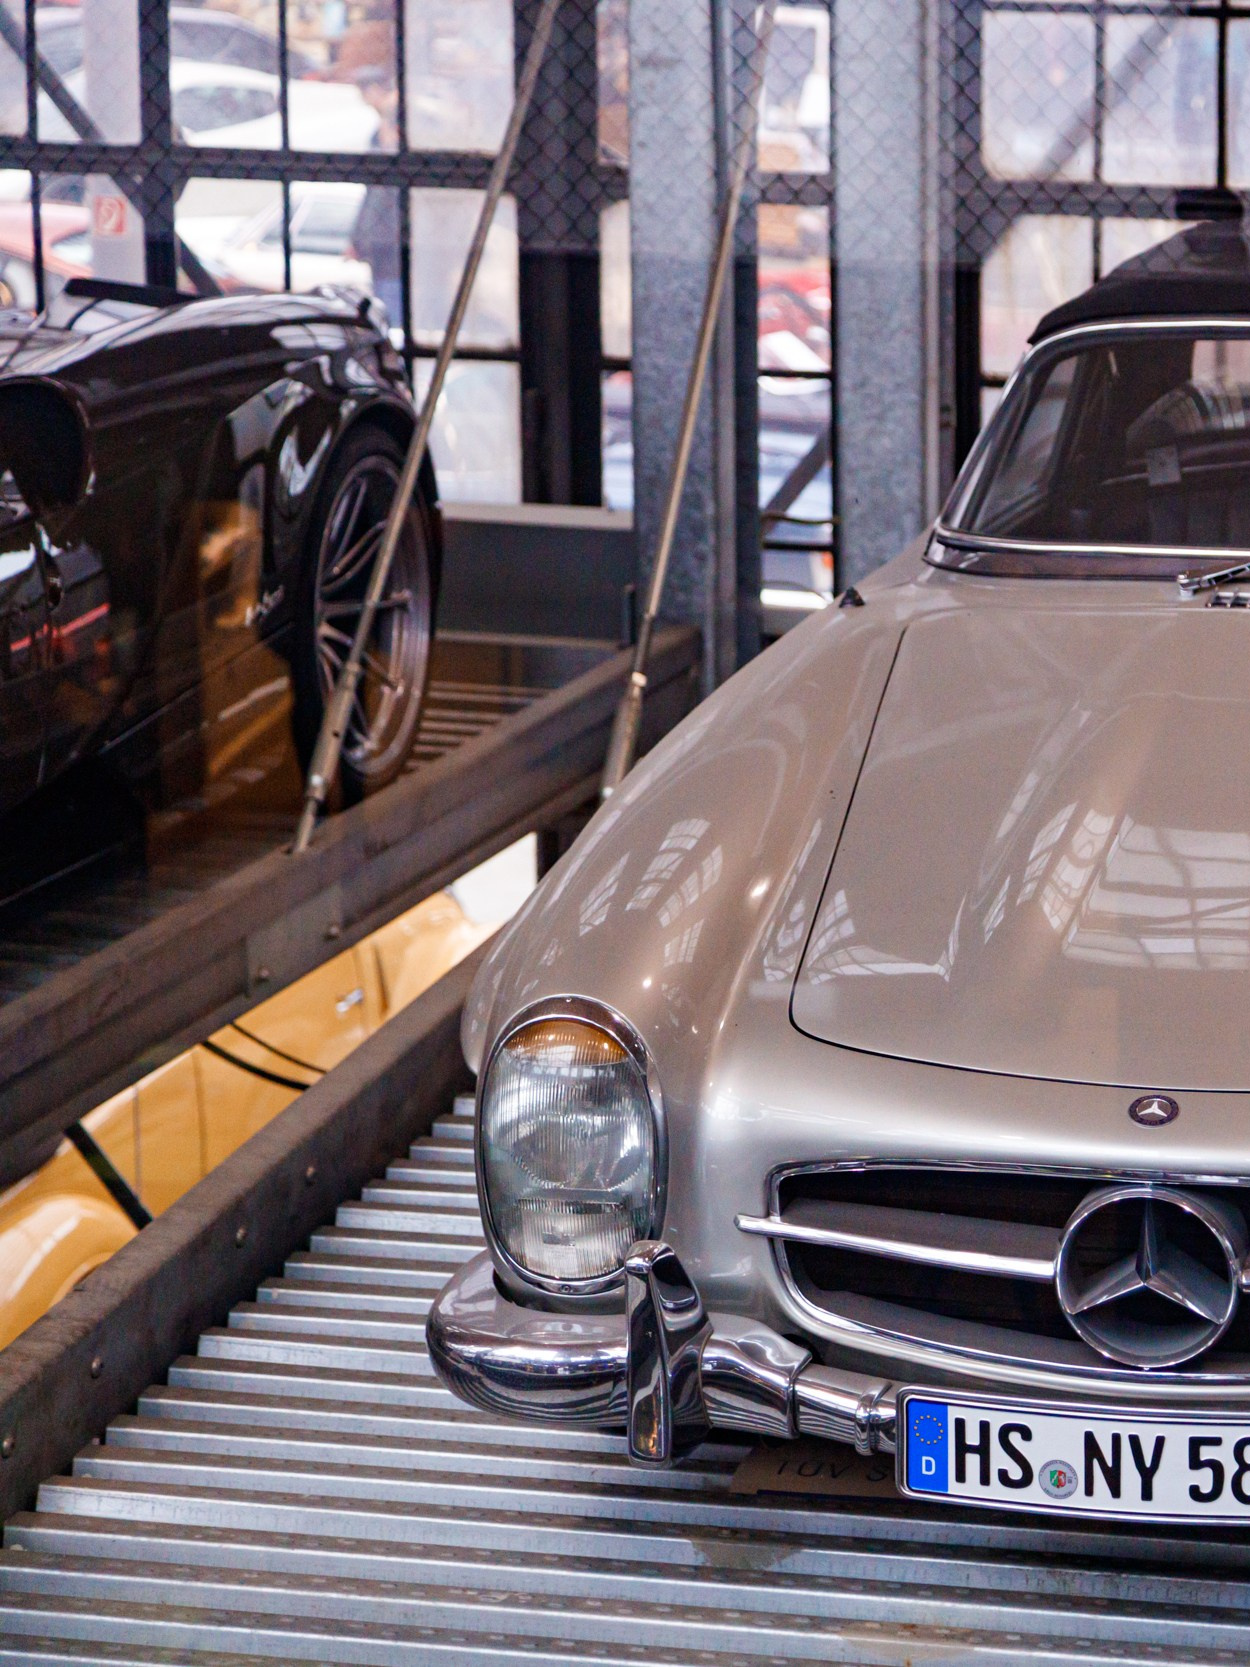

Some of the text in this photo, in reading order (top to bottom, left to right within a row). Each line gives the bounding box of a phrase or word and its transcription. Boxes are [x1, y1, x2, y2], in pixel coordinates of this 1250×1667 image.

[921, 1456, 936, 1476] D
[954, 1417, 1034, 1489] HS
[1084, 1430, 1166, 1502] NY
